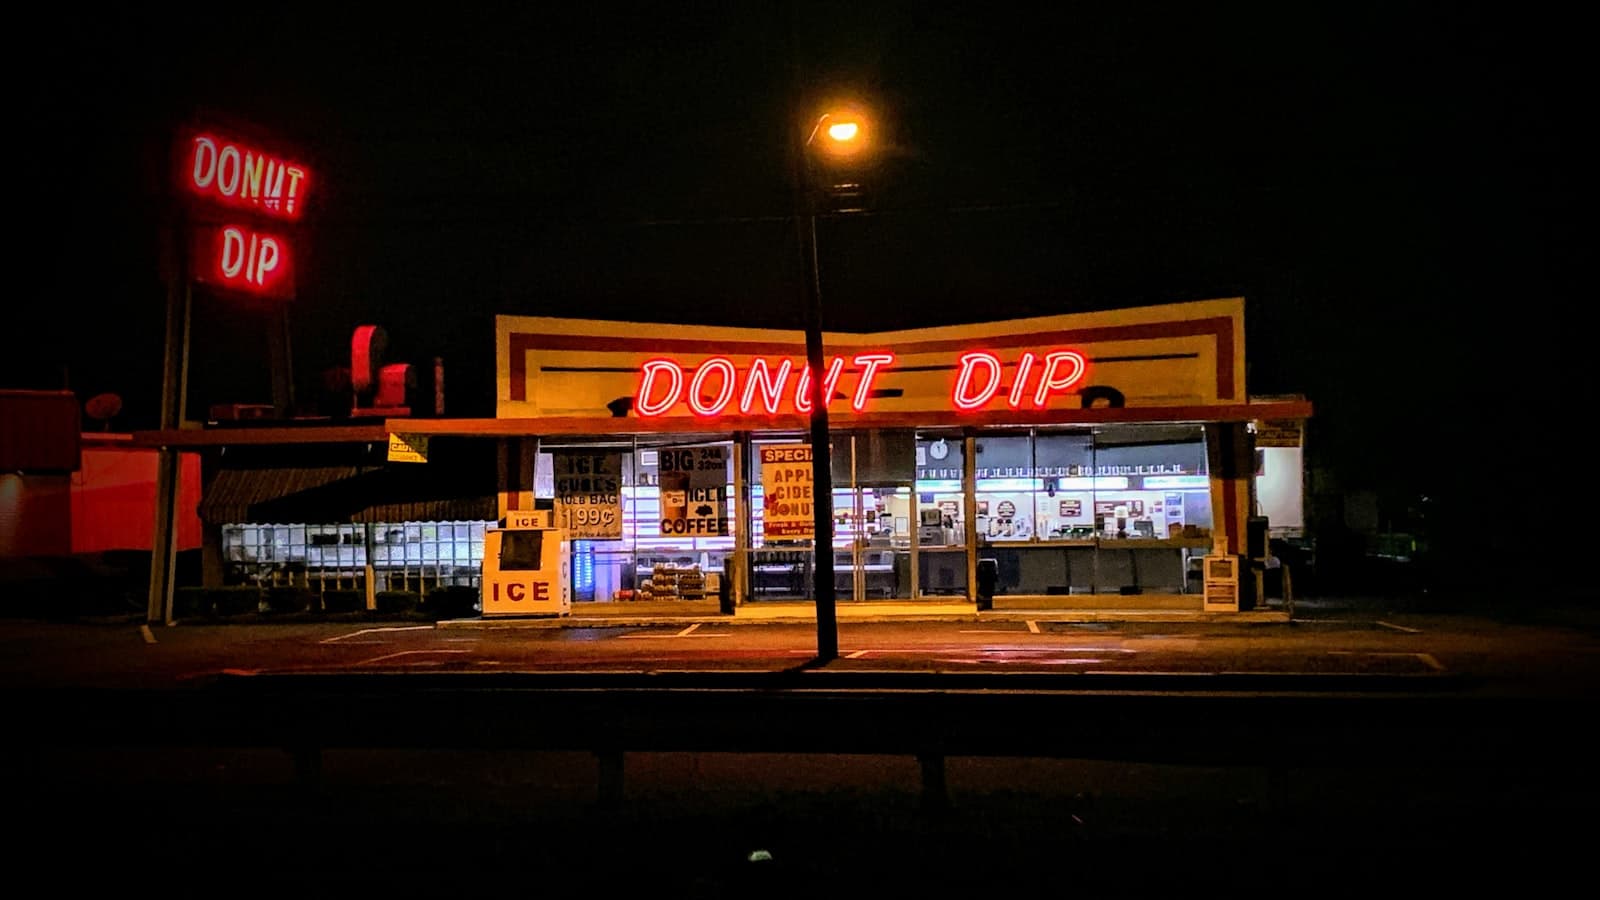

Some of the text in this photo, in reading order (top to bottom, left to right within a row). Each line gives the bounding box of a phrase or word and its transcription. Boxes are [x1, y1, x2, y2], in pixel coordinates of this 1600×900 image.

[193, 137, 304, 214] DONUT
[221, 227, 279, 285] DIP
[637, 351, 1086, 415] DONUT DIP
[567, 456, 608, 475] ICE
[660, 450, 694, 471] BIG
[558, 478, 617, 492] CUBES
[689, 487, 727, 502] ICED
[590, 495, 617, 505] BAG
[515, 518, 539, 527] ICE
[661, 517, 729, 534] COFFEE
[493, 581, 549, 602] ICE
